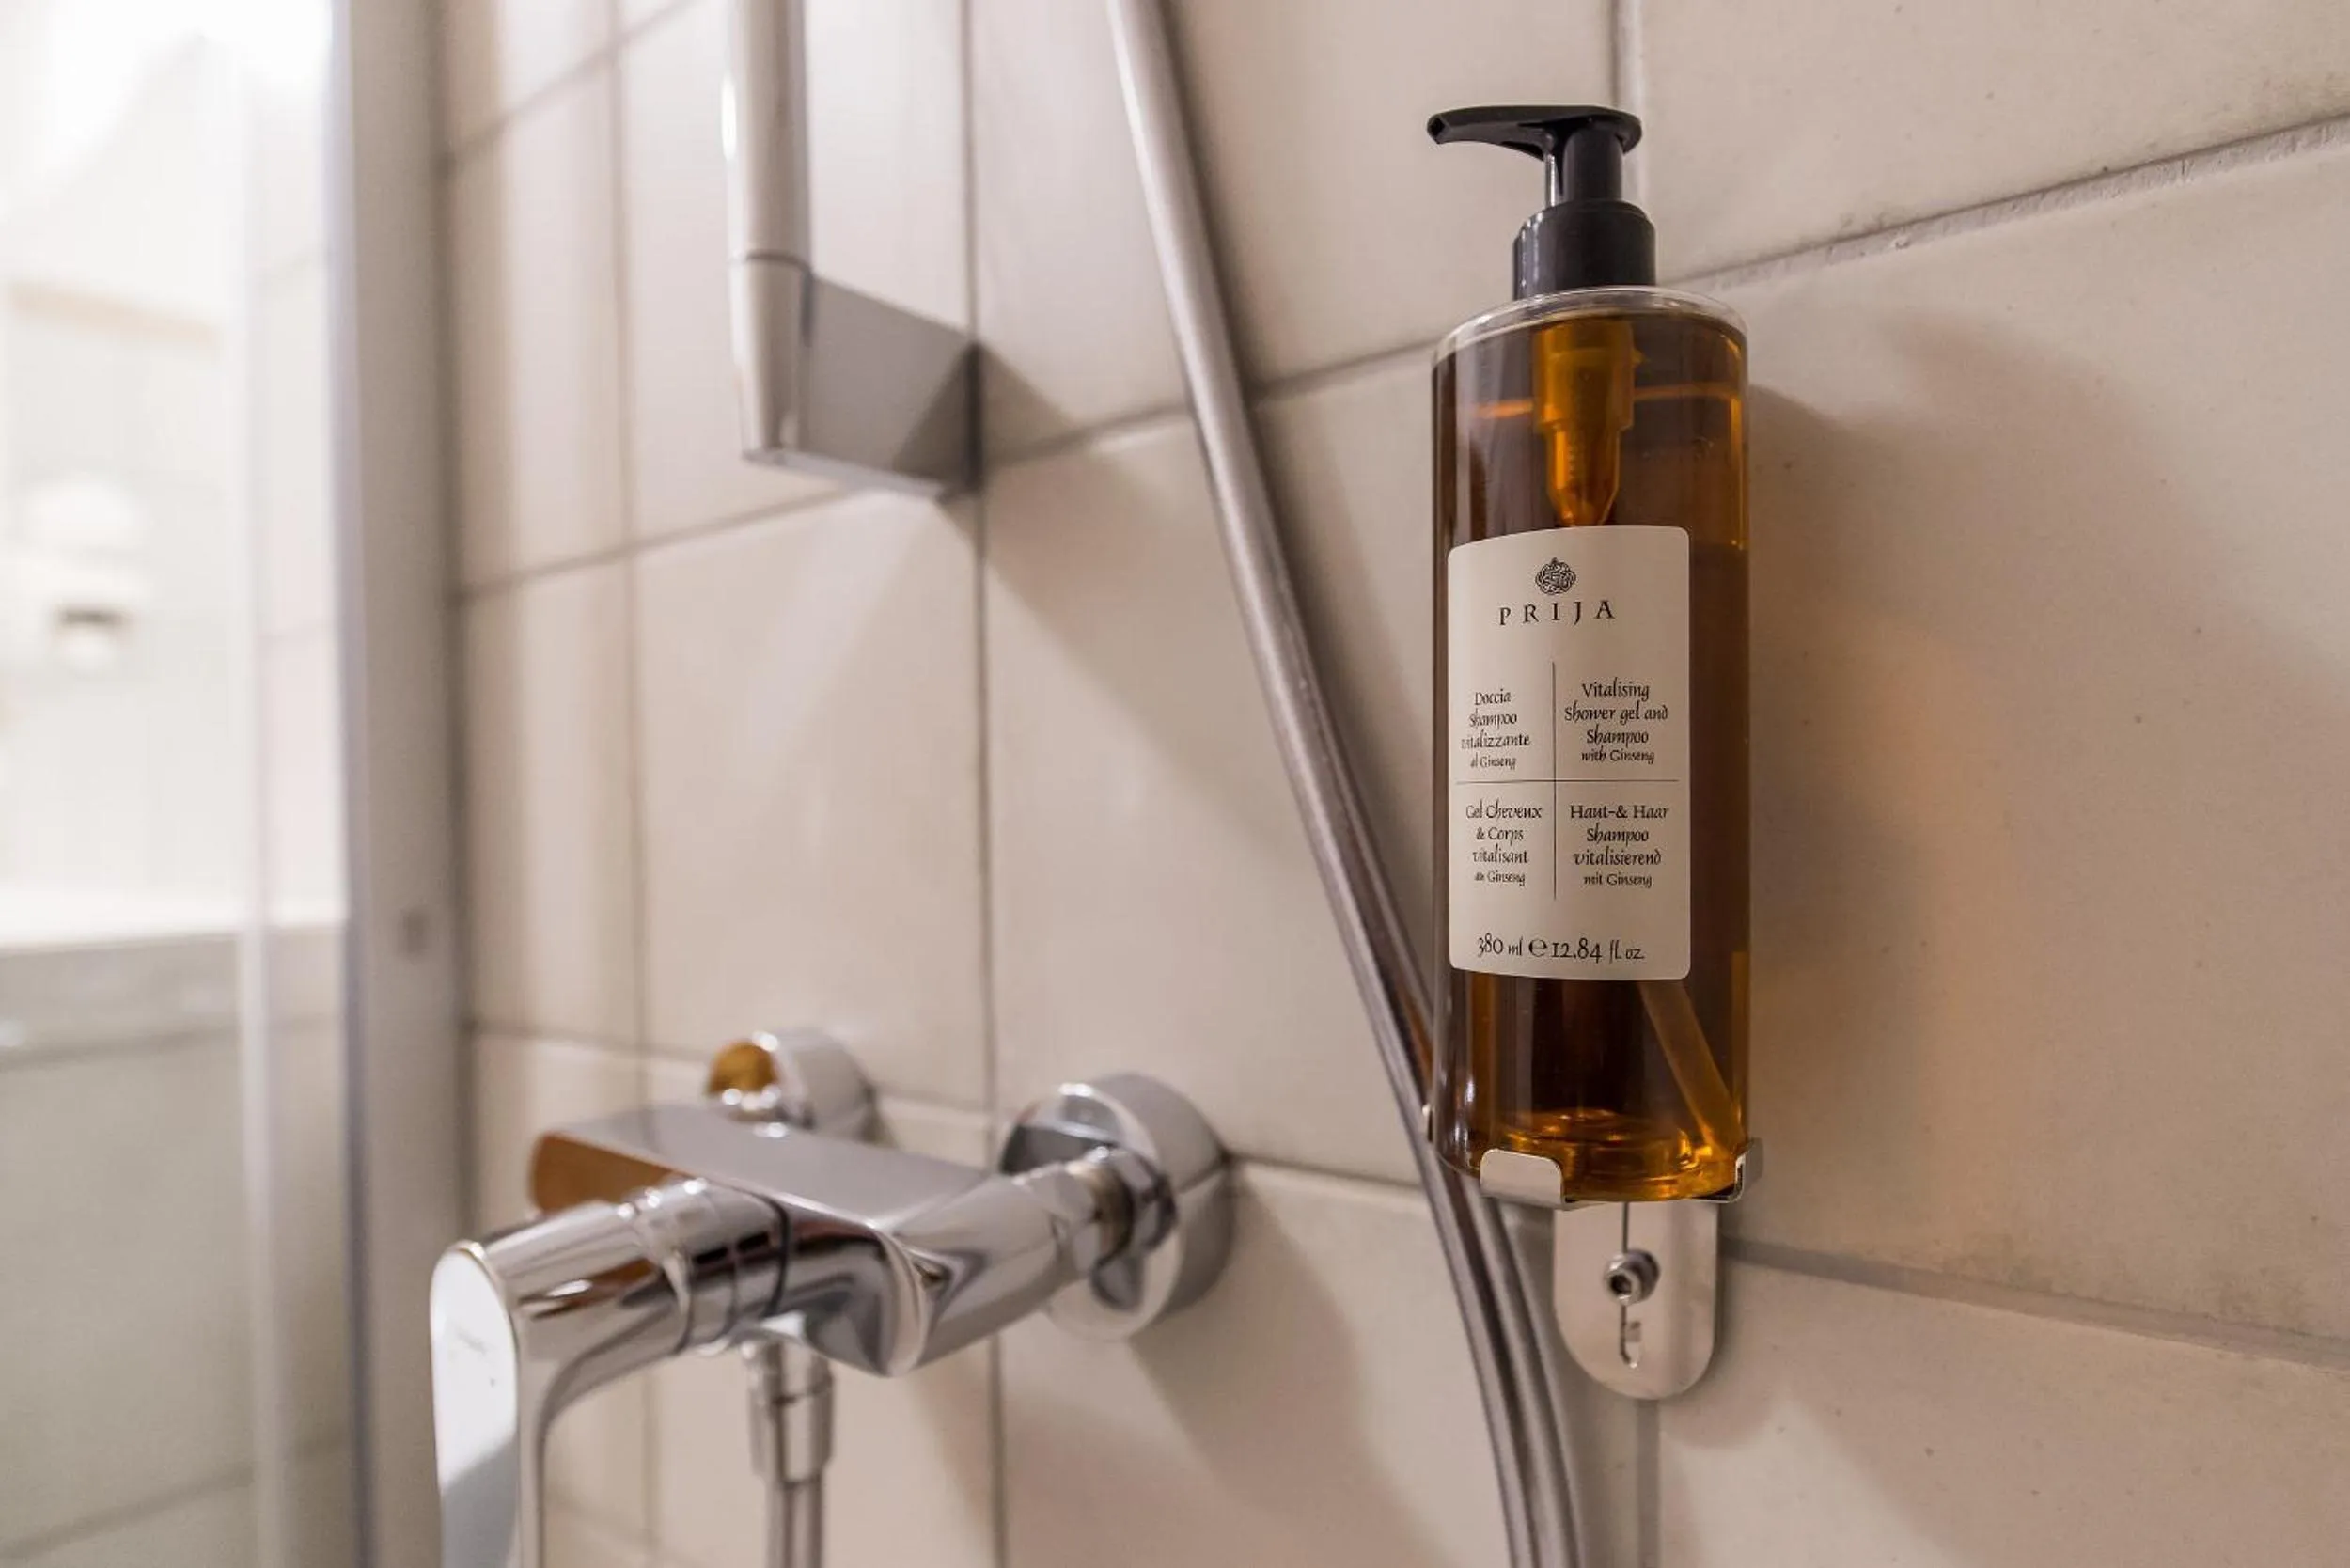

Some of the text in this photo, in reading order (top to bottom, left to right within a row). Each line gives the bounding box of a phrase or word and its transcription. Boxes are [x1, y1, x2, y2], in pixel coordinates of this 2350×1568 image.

[1498, 599, 1616, 626] PRIJA
[1474, 688, 1512, 706] Doccia
[1581, 677, 1651, 702] Vitalising
[1468, 709, 1518, 730] Shampoo
[1564, 699, 1668, 726] Shower gel and
[1586, 724, 1650, 749] Shampoo
[1480, 755, 1517, 770] Ginseng
[1581, 745, 1655, 765] with Ginseng
[1465, 798, 1544, 821] Gel Cheveux
[1633, 805, 1670, 819] Haar
[1476, 826, 1525, 847] & Corps
[1586, 822, 1650, 847] Shampoo
[1472, 842, 1529, 864] vitalisant
[1574, 845, 1663, 866] vitalisierend
[1487, 870, 1527, 886] Ginseng
[1583, 872, 1653, 889] mit Ginseng
[1477, 933, 1504, 958] 380
[1508, 936, 1524, 957] ml
[1550, 937, 1603, 964] 12.84
